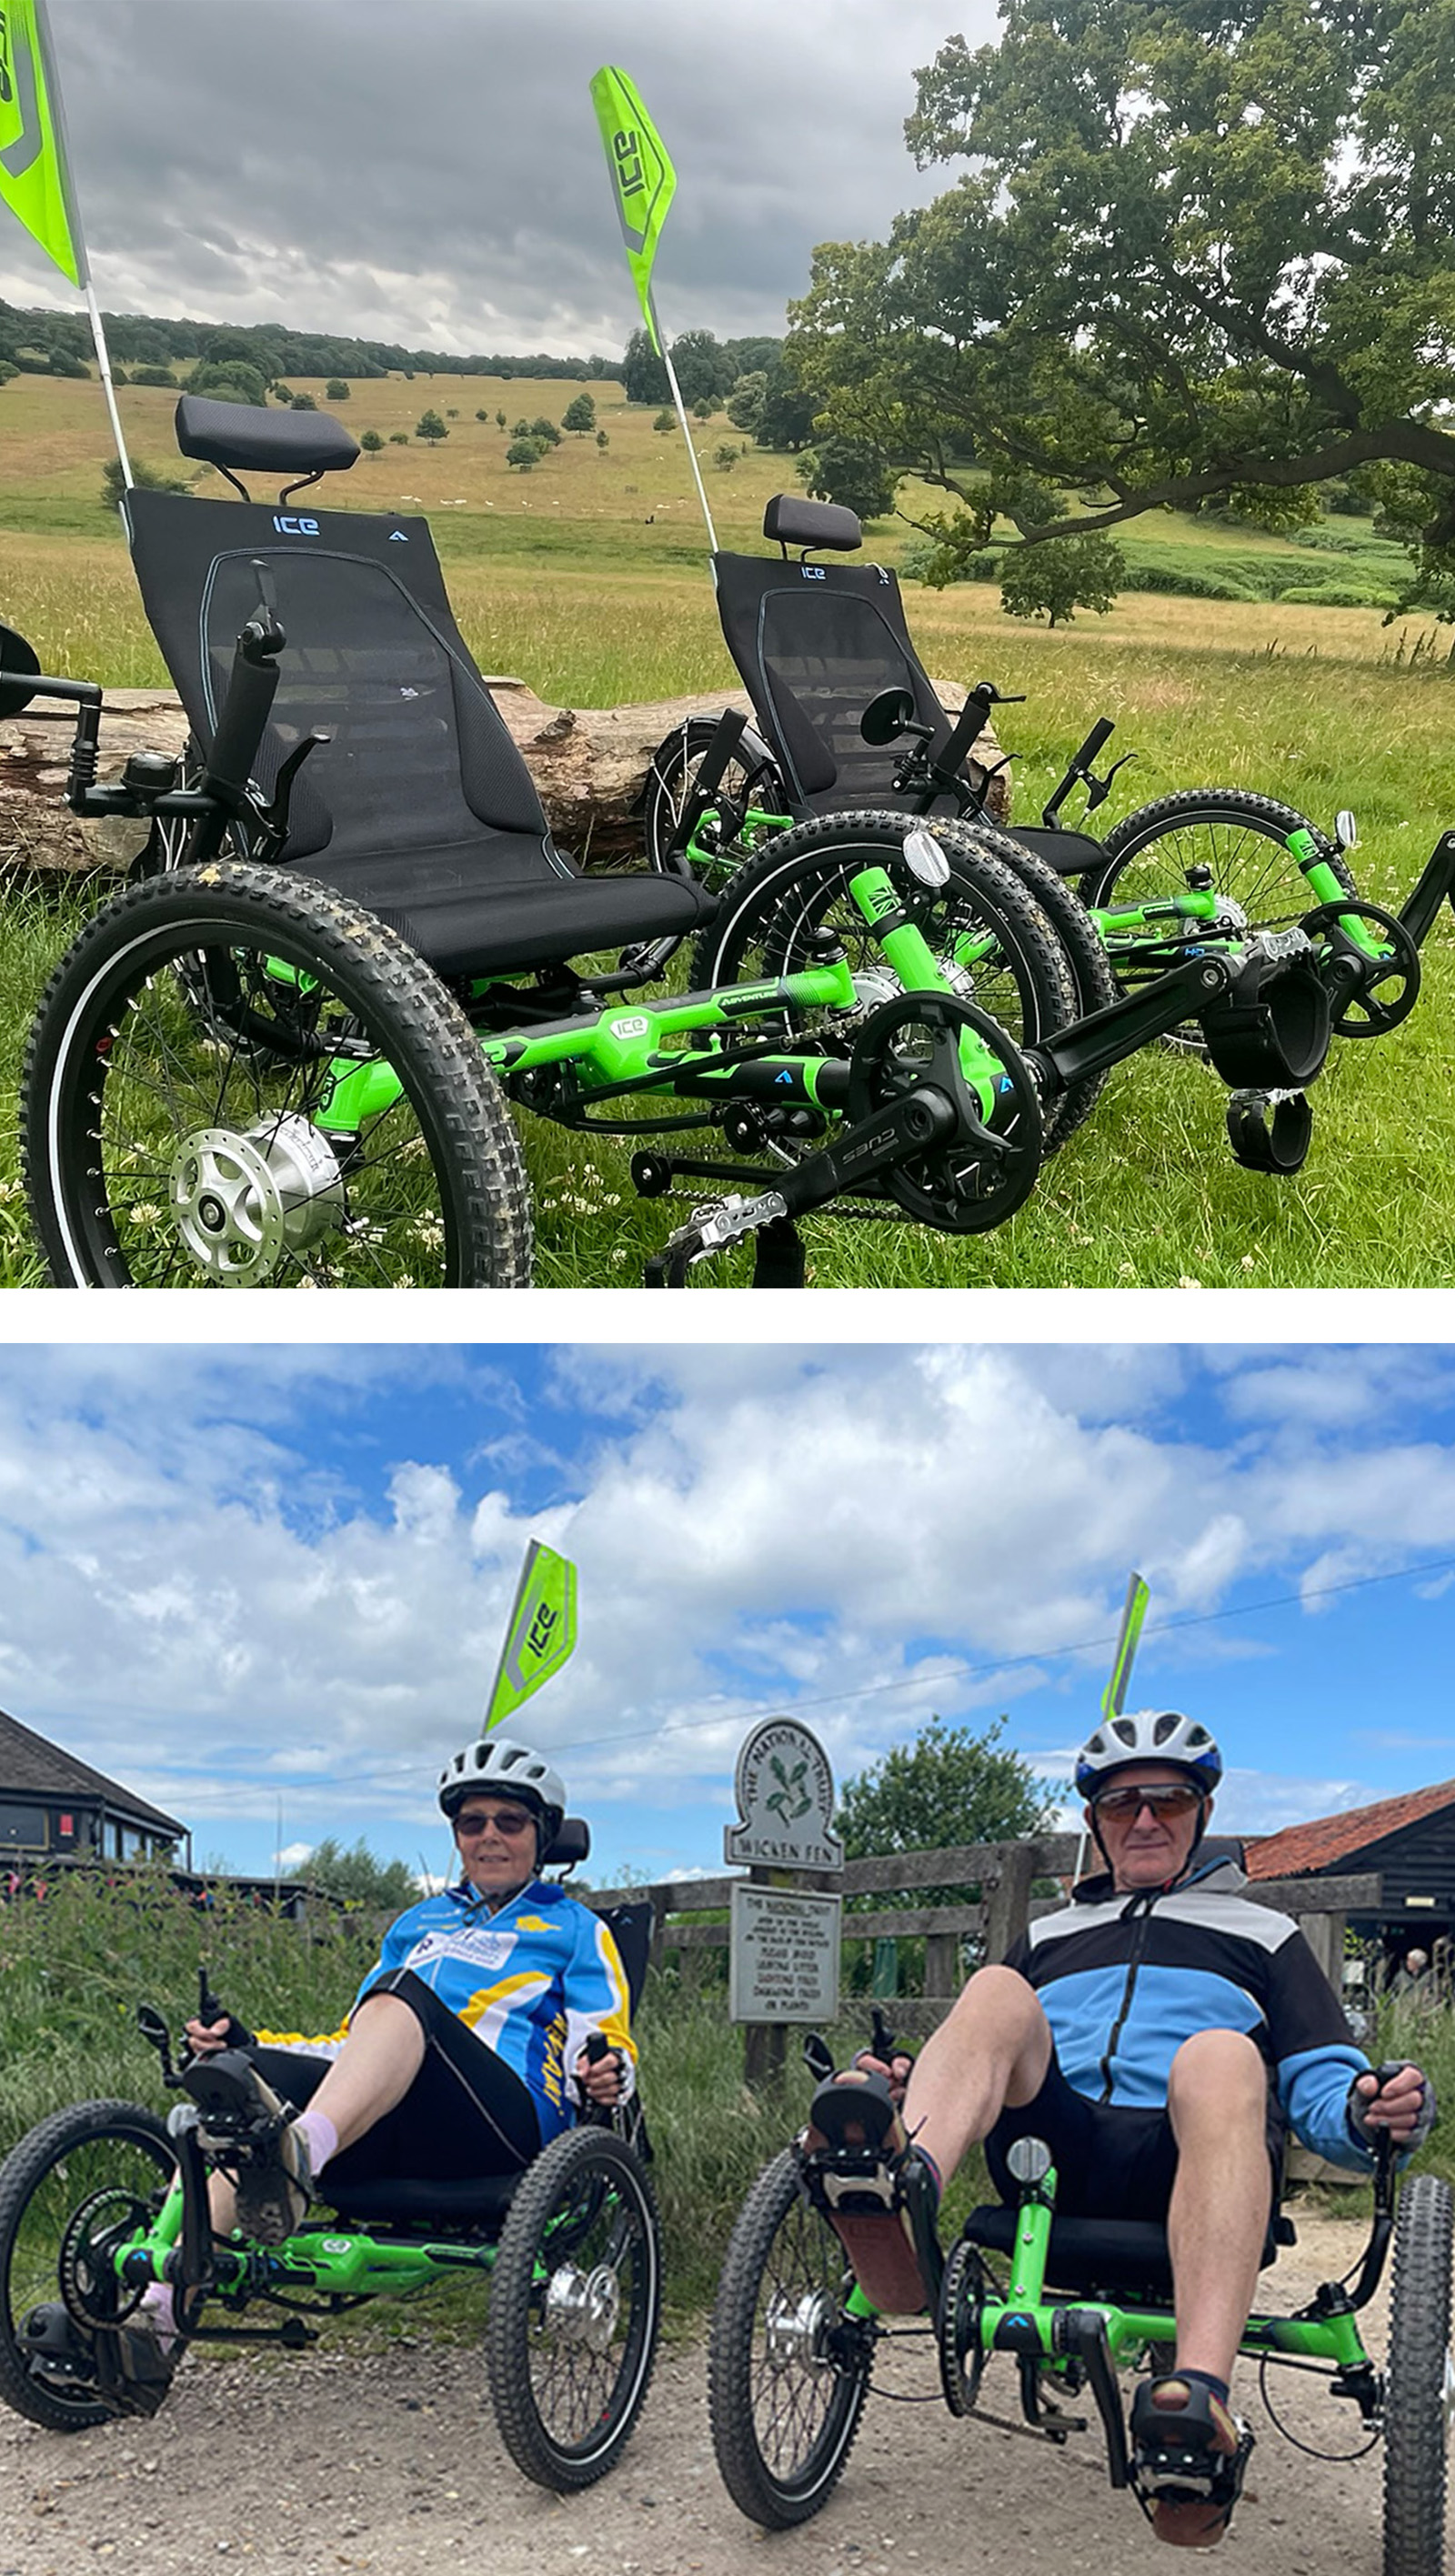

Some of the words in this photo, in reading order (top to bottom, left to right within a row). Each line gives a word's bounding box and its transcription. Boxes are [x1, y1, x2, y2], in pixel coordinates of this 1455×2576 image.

[721, 990, 778, 1007] ADVENTURE
[842, 1128, 896, 1165] CUES
[748, 1771, 758, 1807] THE
[753, 1729, 812, 1765] NATIONAL
[739, 1839, 799, 1859] WICKEN
[806, 1844, 833, 1861] FEN
